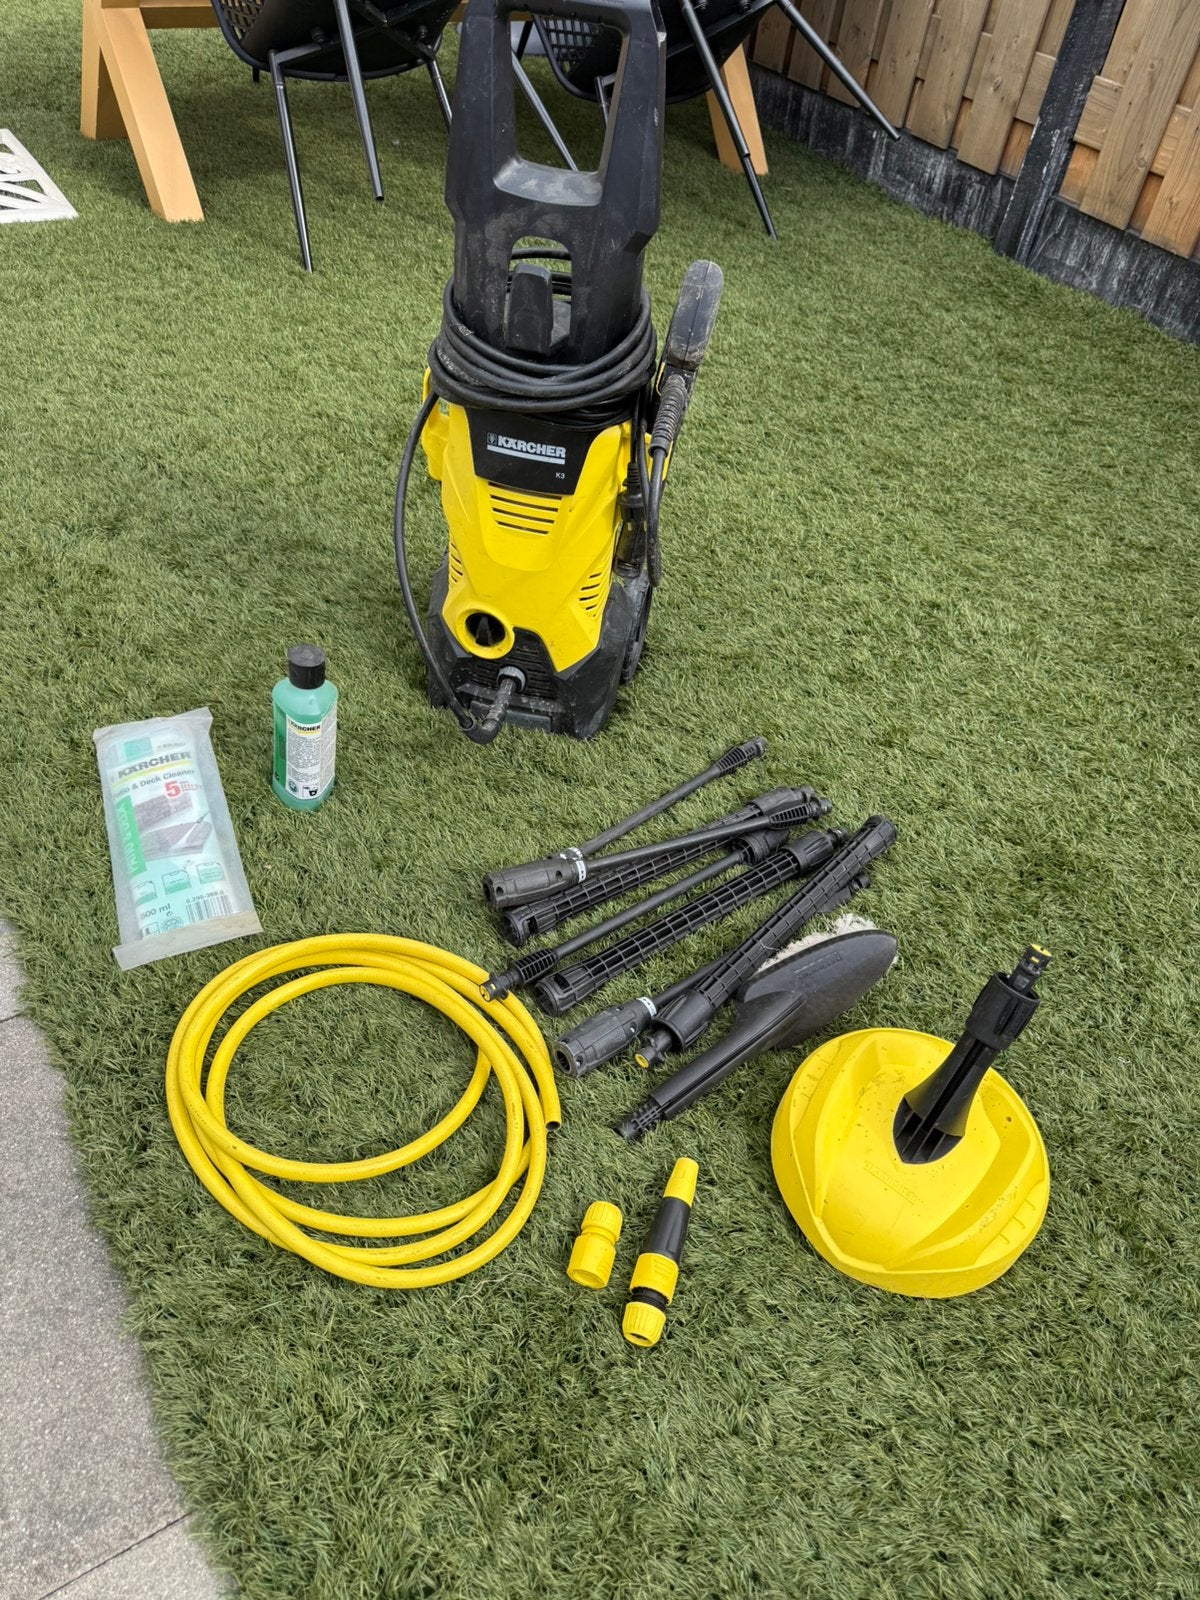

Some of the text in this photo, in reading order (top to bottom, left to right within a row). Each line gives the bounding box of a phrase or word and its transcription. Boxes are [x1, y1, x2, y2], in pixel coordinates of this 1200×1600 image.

[498, 435, 566, 458] KÄRCHER
[555, 472, 565, 480] K3
[118, 751, 191, 778] KÄRCHER
[131, 783, 138, 791] &
[140, 775, 162, 787] Deck
[163, 769, 195, 780] Cleaner
[164, 780, 181, 798] 5
[158, 903, 171, 913] ml
